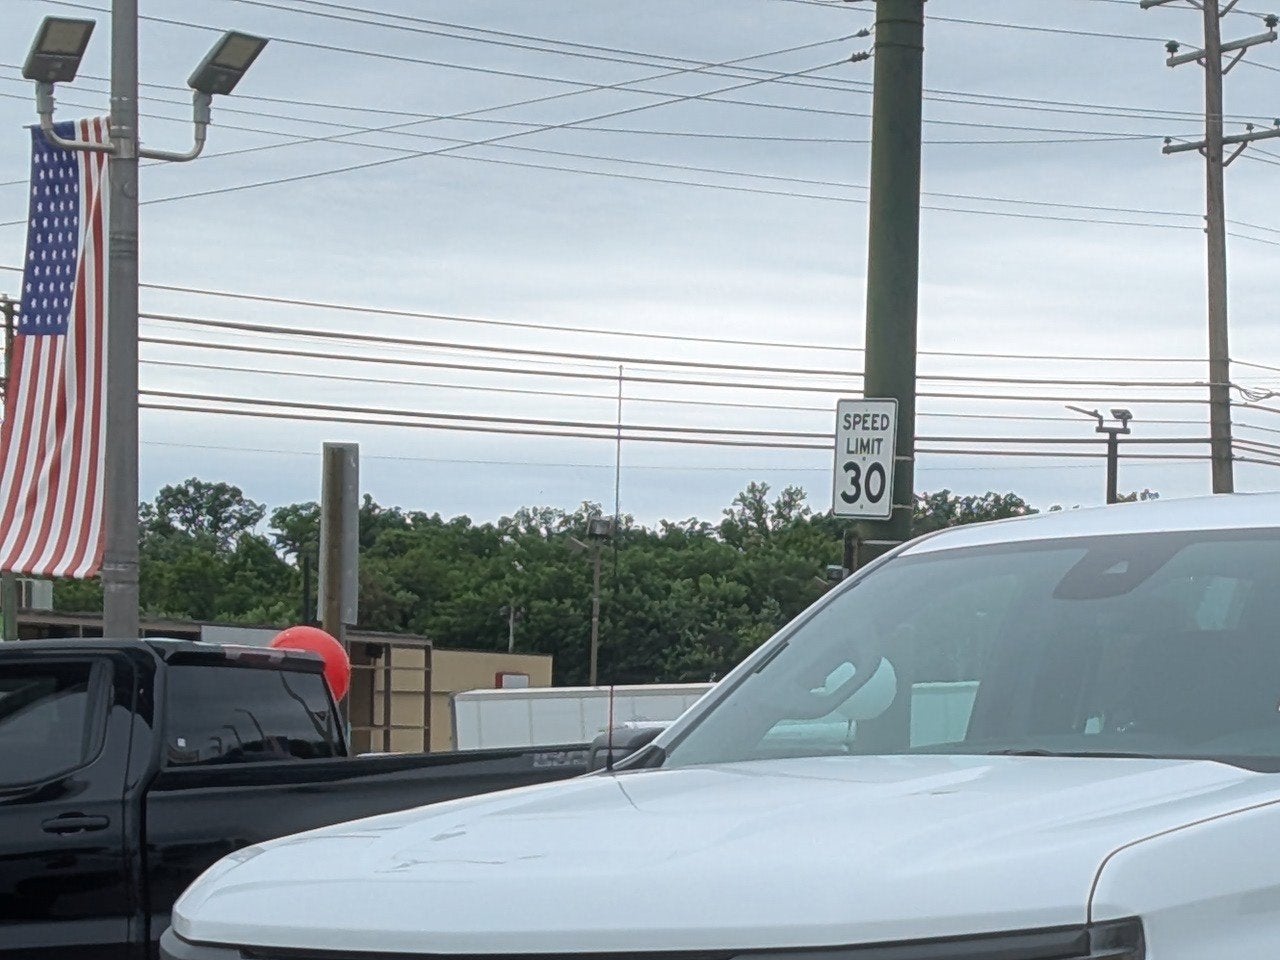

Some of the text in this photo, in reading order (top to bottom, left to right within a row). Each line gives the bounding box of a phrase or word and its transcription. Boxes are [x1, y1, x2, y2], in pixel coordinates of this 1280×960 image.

[843, 413, 890, 431] SPEED
[846, 437, 883, 454] LIMIT
[841, 461, 886, 504] 30
